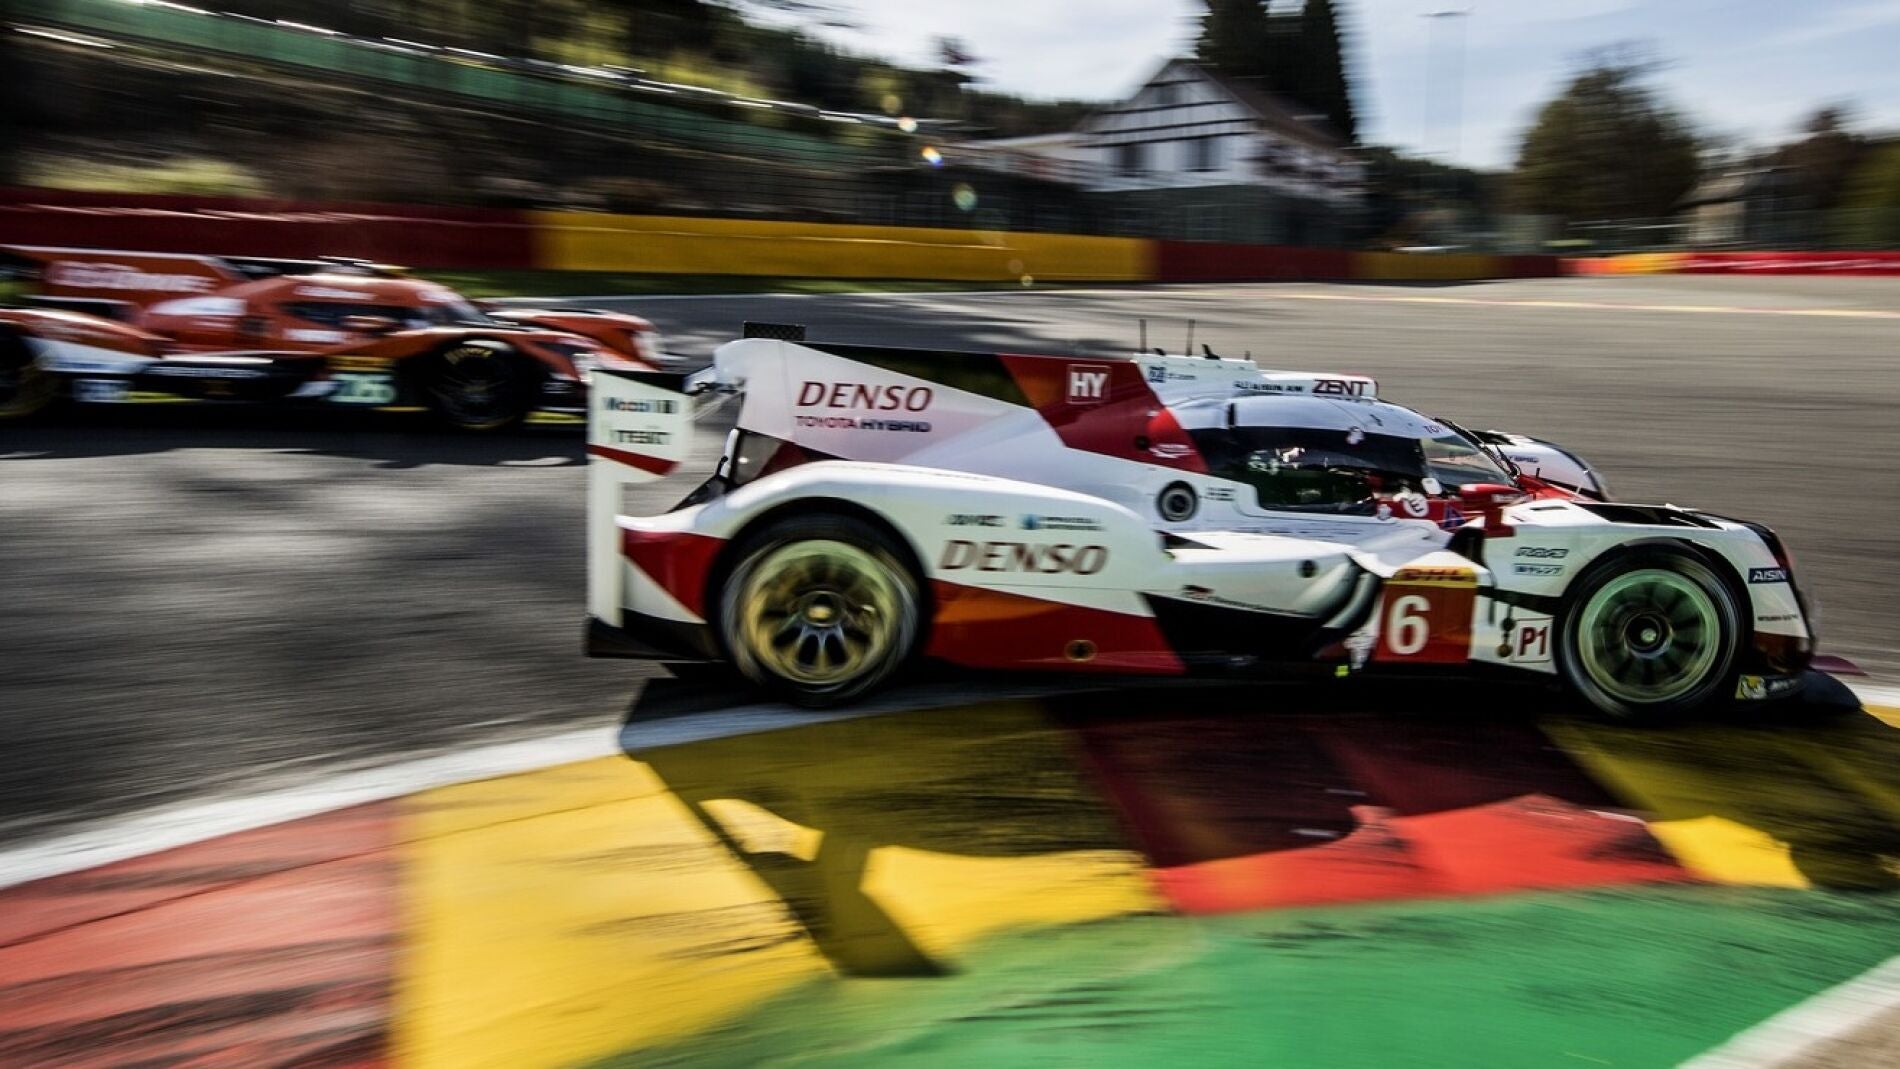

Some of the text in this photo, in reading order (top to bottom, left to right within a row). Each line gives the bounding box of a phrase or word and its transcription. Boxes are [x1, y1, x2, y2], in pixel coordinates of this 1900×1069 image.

[796, 381, 933, 412] DENSO
[1068, 371, 1108, 398] HY
[1312, 378, 1370, 396] ZENT
[795, 415, 932, 432] TOYOTA HYBRID
[939, 539, 1108, 575] DENSO
[1753, 570, 1787, 581] AISIN
[1386, 595, 1432, 655] 6
[1519, 625, 1548, 656] P1
